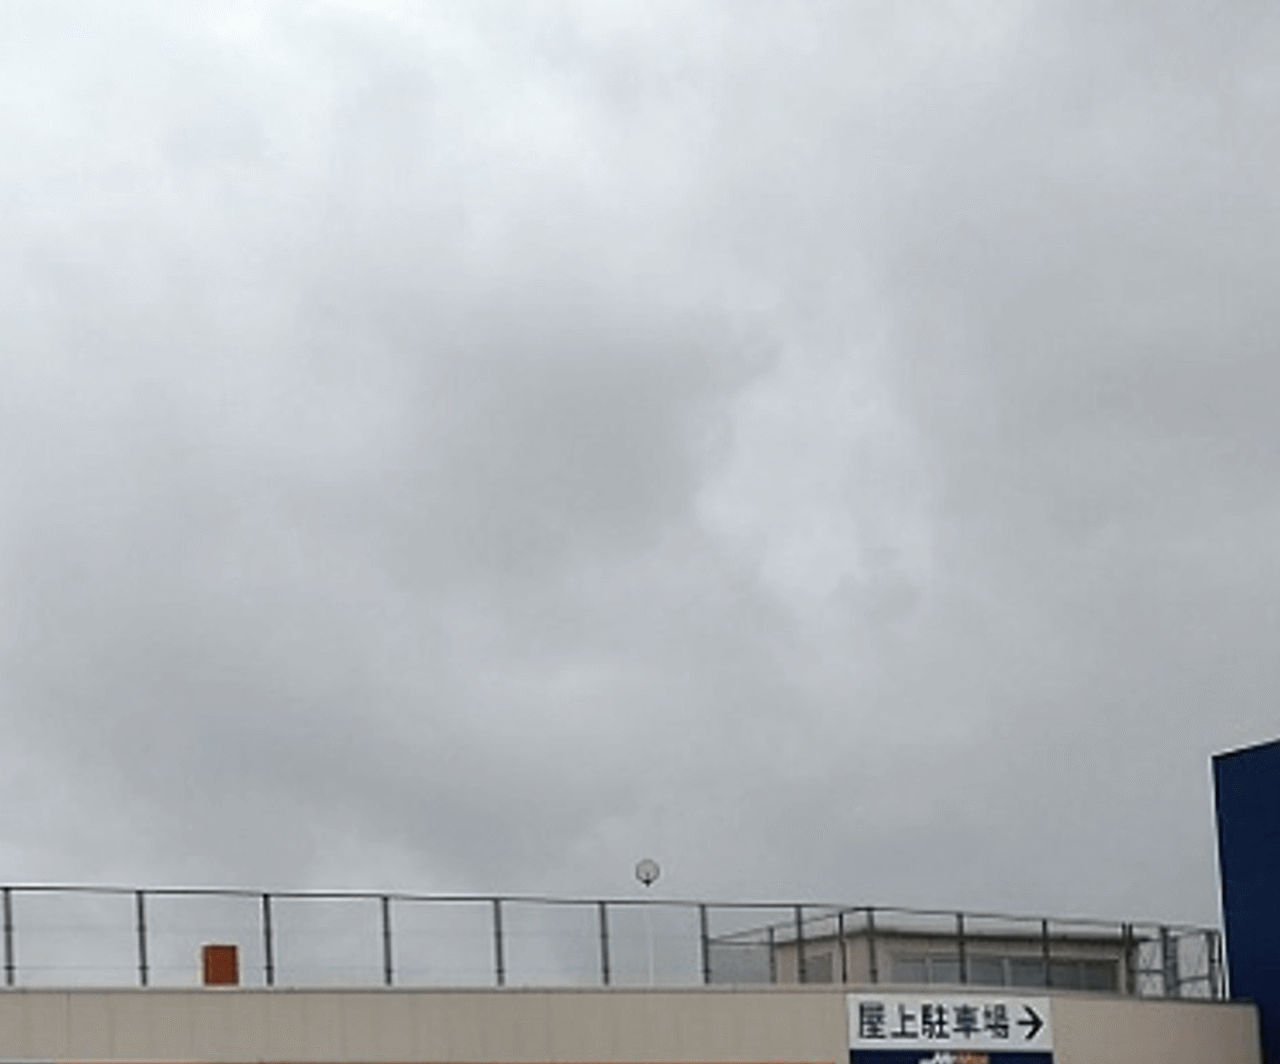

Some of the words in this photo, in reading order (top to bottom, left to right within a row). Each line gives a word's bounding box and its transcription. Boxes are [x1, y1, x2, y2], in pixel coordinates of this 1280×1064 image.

[858, 1002, 1010, 1040] 屋上駐車場
